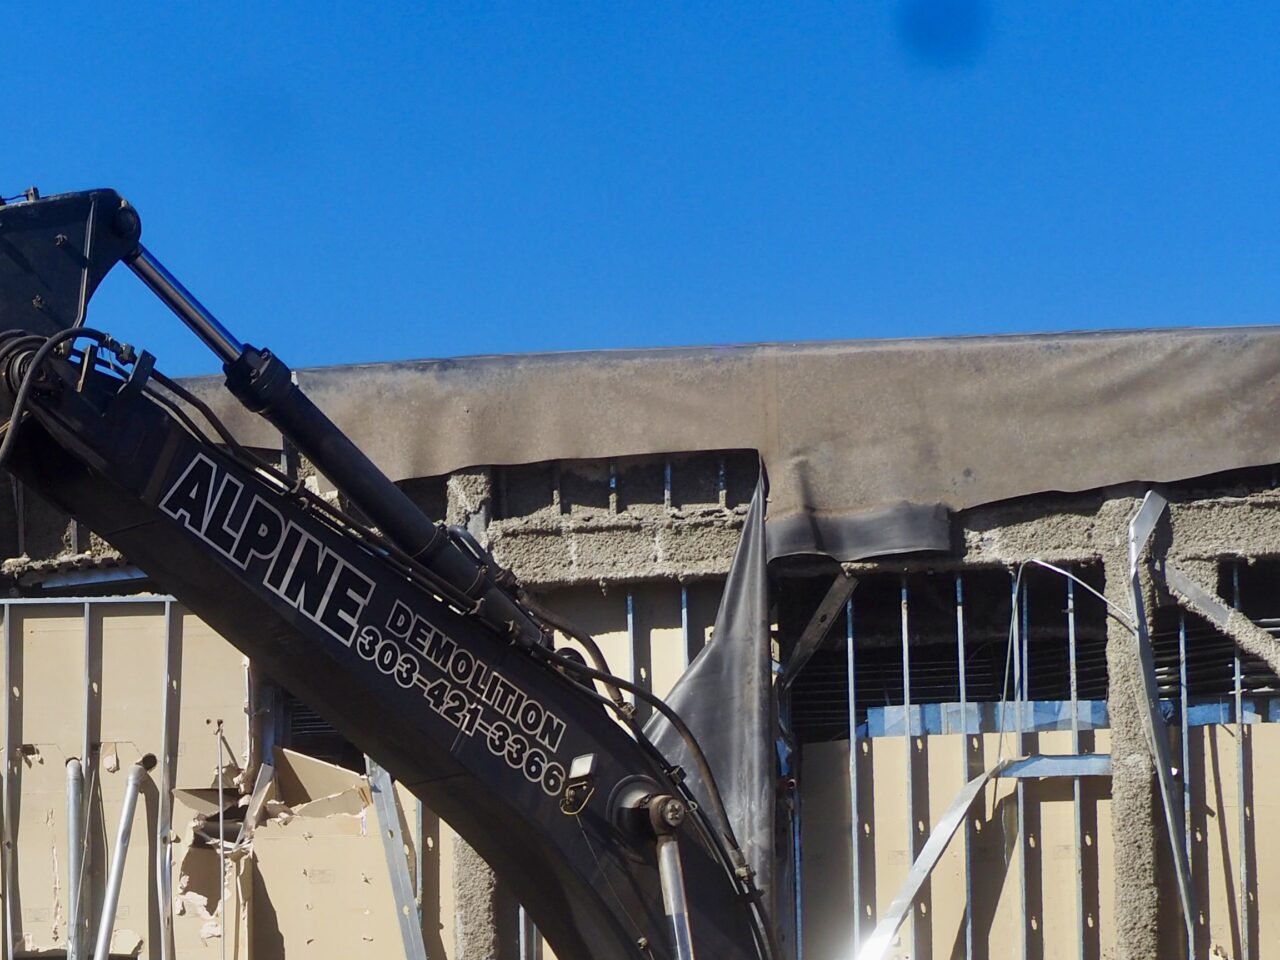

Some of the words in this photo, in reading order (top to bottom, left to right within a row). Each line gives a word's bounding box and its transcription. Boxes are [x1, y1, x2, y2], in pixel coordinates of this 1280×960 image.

[158, 452, 376, 648] ALPINE
[356, 625, 566, 796] 303-421-3366
[385, 599, 567, 753] DEMOLITION
